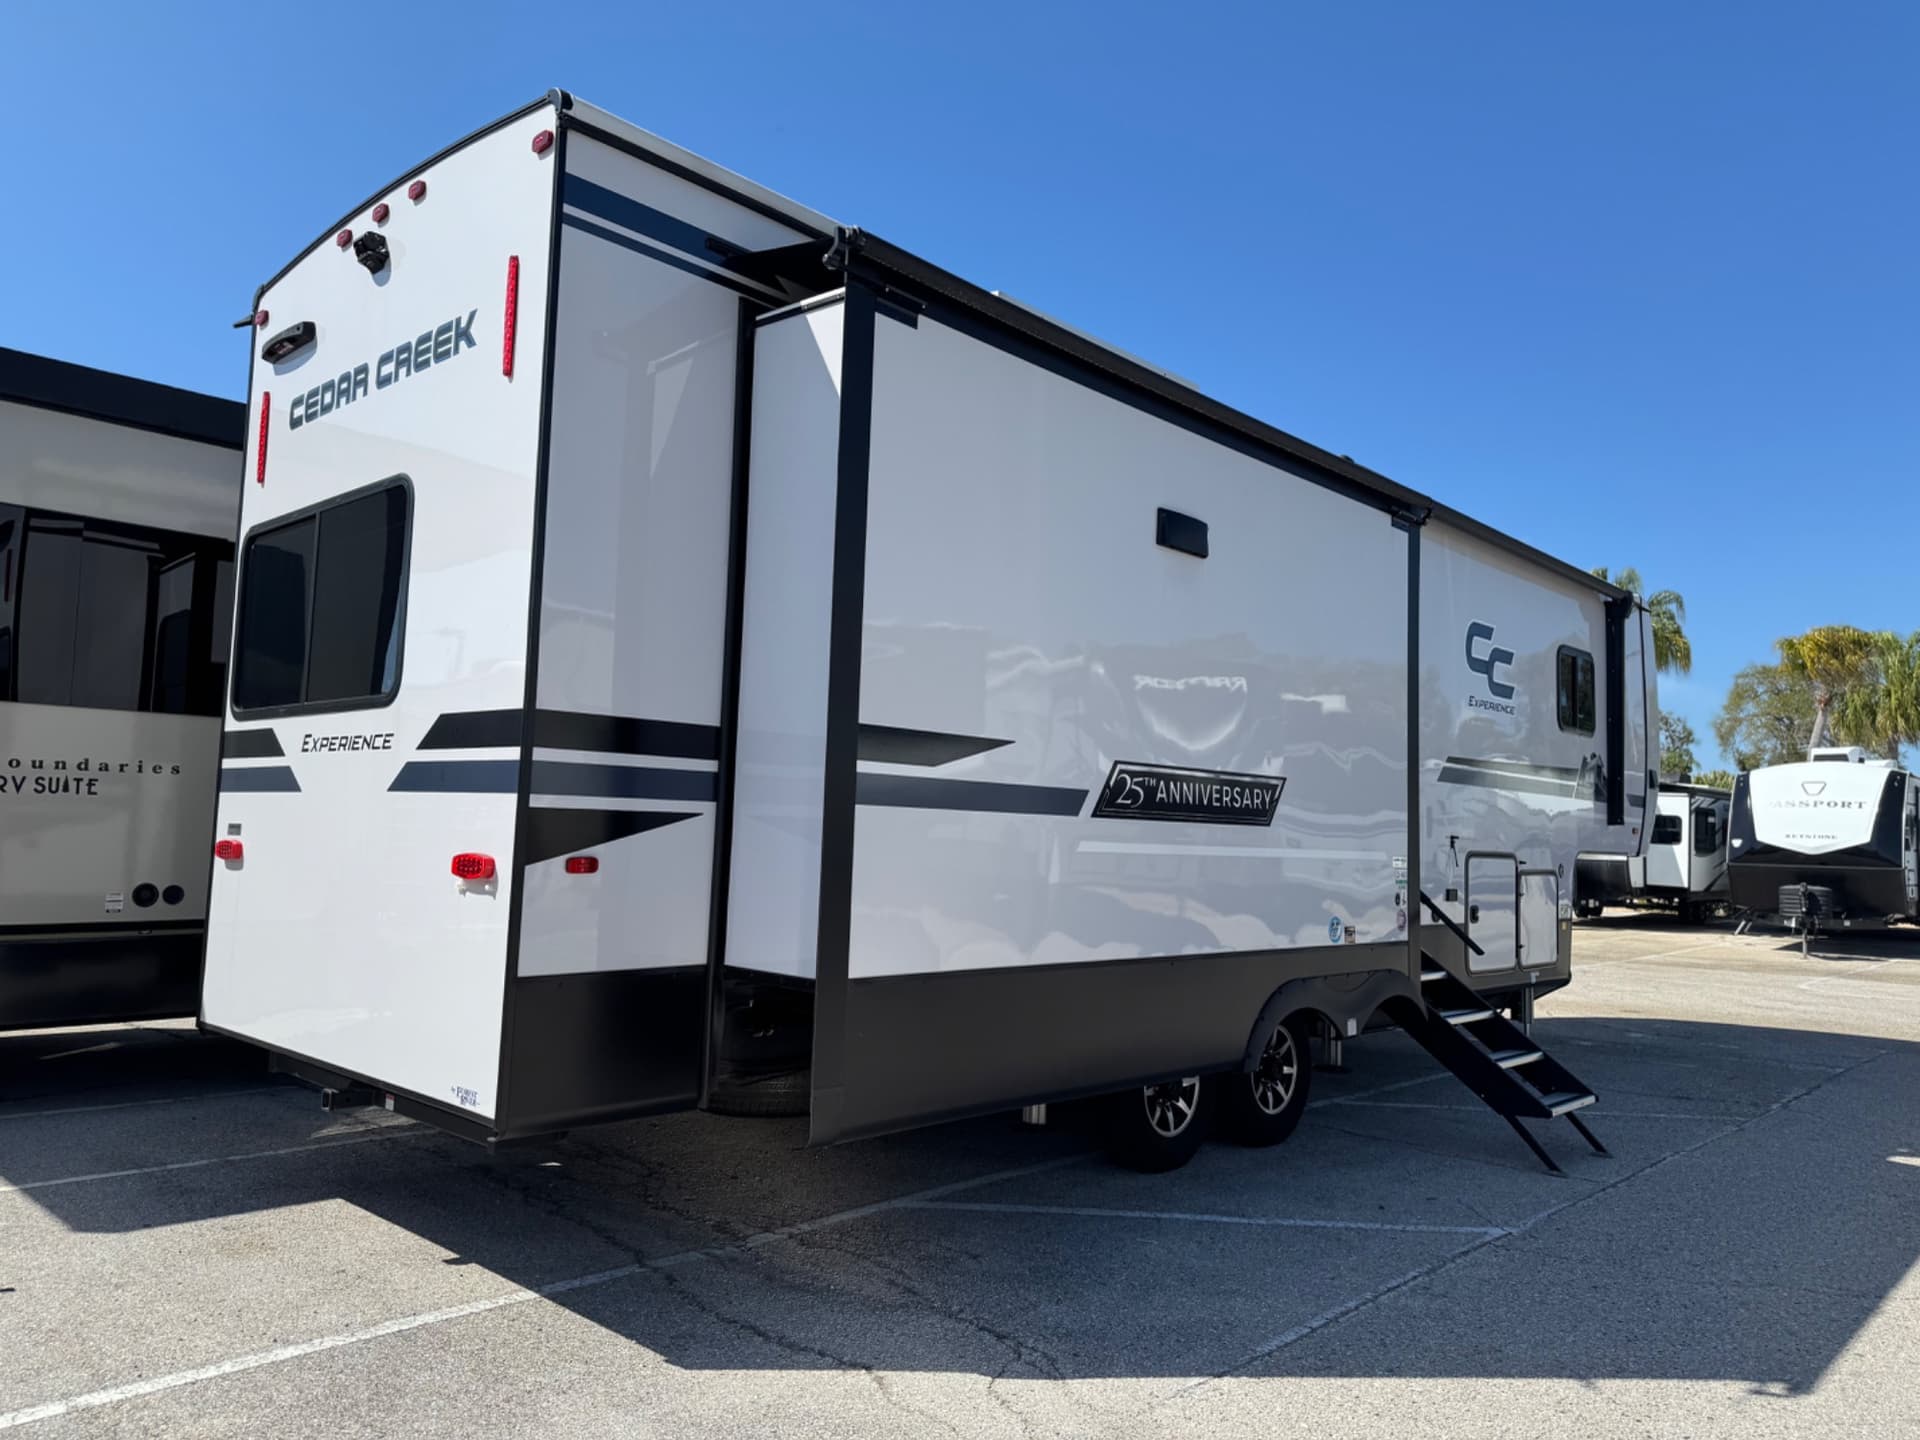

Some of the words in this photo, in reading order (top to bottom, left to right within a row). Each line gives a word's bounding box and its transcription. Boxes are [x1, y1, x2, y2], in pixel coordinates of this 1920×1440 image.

[289, 362, 370, 431] CEDAR
[375, 308, 478, 390] CREEK
[301, 733, 394, 752] EXPERIENCE
[33, 774, 99, 796] SUITE
[1155, 781, 1272, 809] ANNIVERSARY
